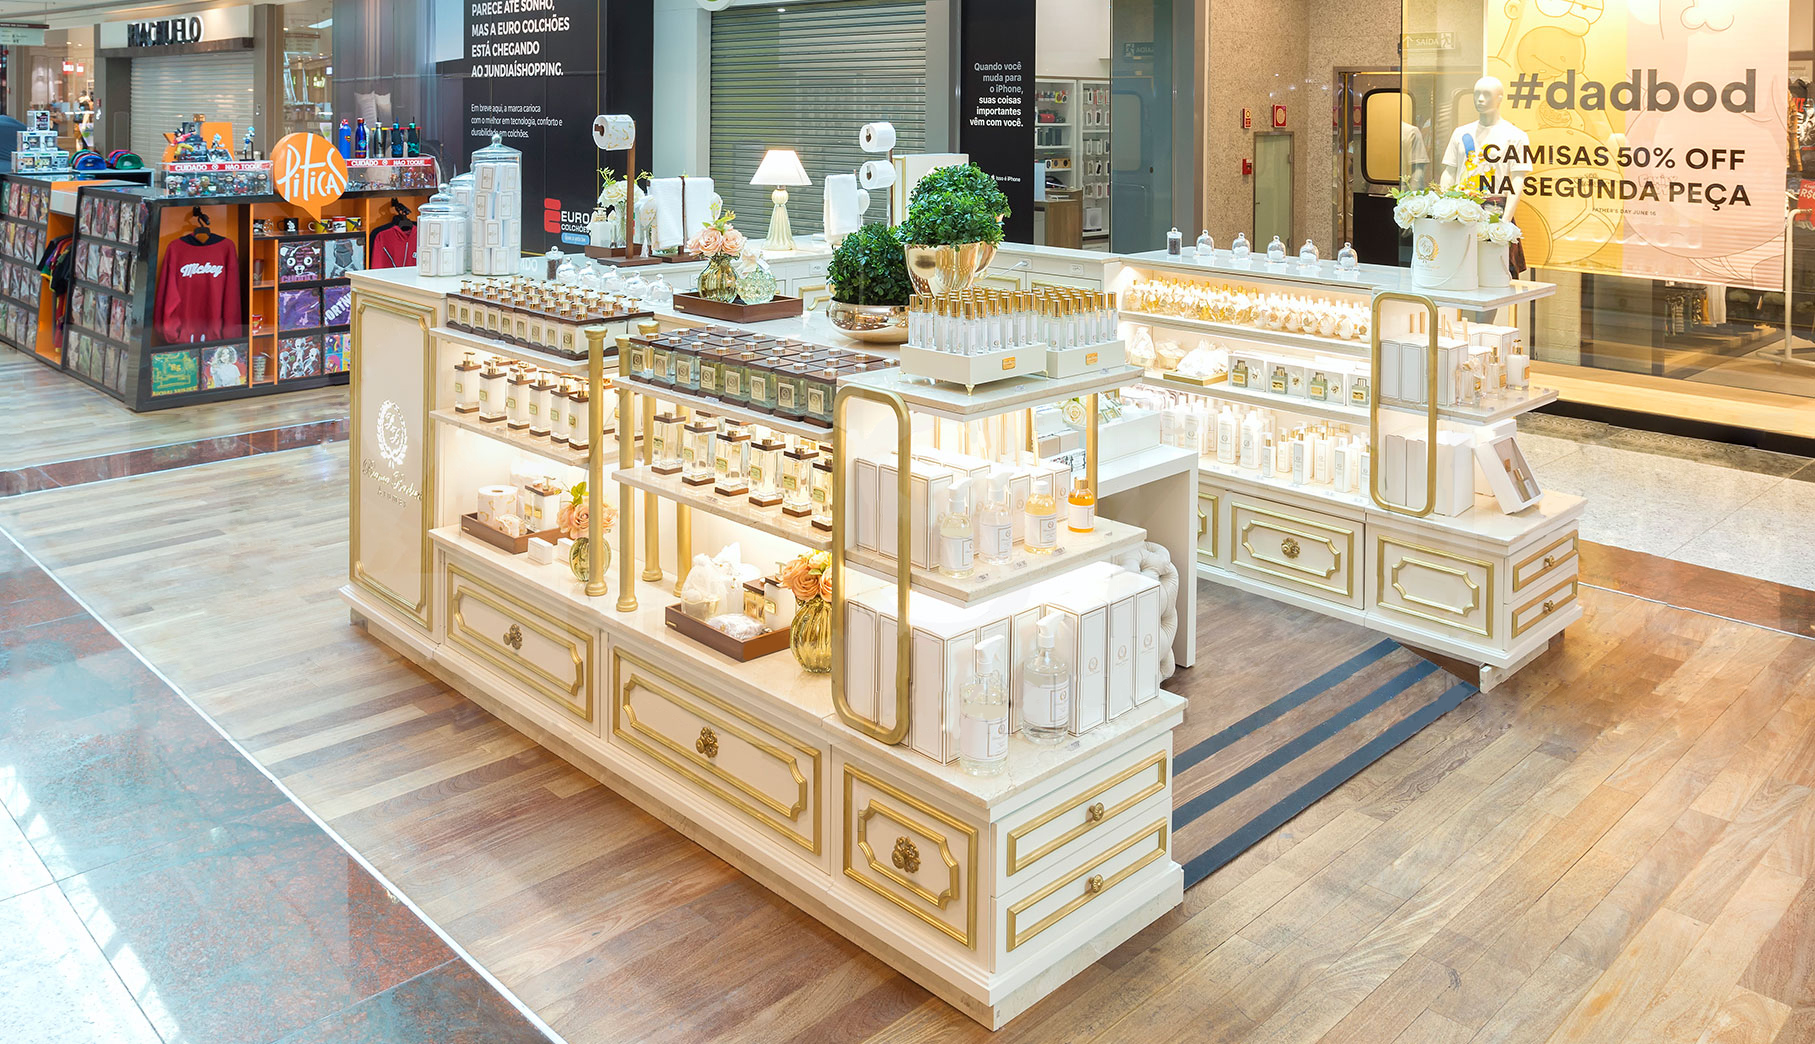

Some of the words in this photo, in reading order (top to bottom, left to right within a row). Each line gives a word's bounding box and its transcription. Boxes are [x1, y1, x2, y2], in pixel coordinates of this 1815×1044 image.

[472, 2, 502, 16] PARECE
[520, 0, 555, 12] SONHO,
[472, 23, 489, 37] MAS
[490, 22, 496, 36] A
[497, 20, 520, 35] EURO
[522, 14, 570, 34] COLCHÕES
[472, 41, 491, 57] ESTÁ
[492, 41, 540, 56] CHEGANDO
[471, 64, 483, 78] AO
[484, 60, 564, 77] JUNDIAÍSHOPPING.
[974, 62, 1003, 71] Quando
[1003, 61, 1022, 71] você
[982, 73, 1003, 82] muda
[1004, 75, 1022, 83] para
[995, 84, 1024, 94] iPhone,
[1507, 68, 1756, 114] #dadbod
[997, 95, 1022, 104] coisas
[471, 104, 479, 112] Em
[480, 103, 492, 112] breve
[523, 104, 541, 113] carioca
[976, 106, 1022, 117] importantes
[510, 116, 537, 127] tecnologia,
[537, 116, 559, 126] conforto
[969, 116, 985, 126] vêm
[985, 119, 1002, 127] com
[1002, 117, 1024, 127] você.
[507, 129, 529, 138] colchões.
[1482, 143, 1609, 167] CAMISAS
[1616, 146, 1676, 170] 50%
[1685, 148, 1745, 171] OFF
[1479, 175, 1516, 195] NA
[1522, 176, 1660, 202] SEGUNDA
[1668, 182, 1752, 211] PEÇA
[561, 210, 590, 225] EURO
[180, 262, 223, 278] Mickey
